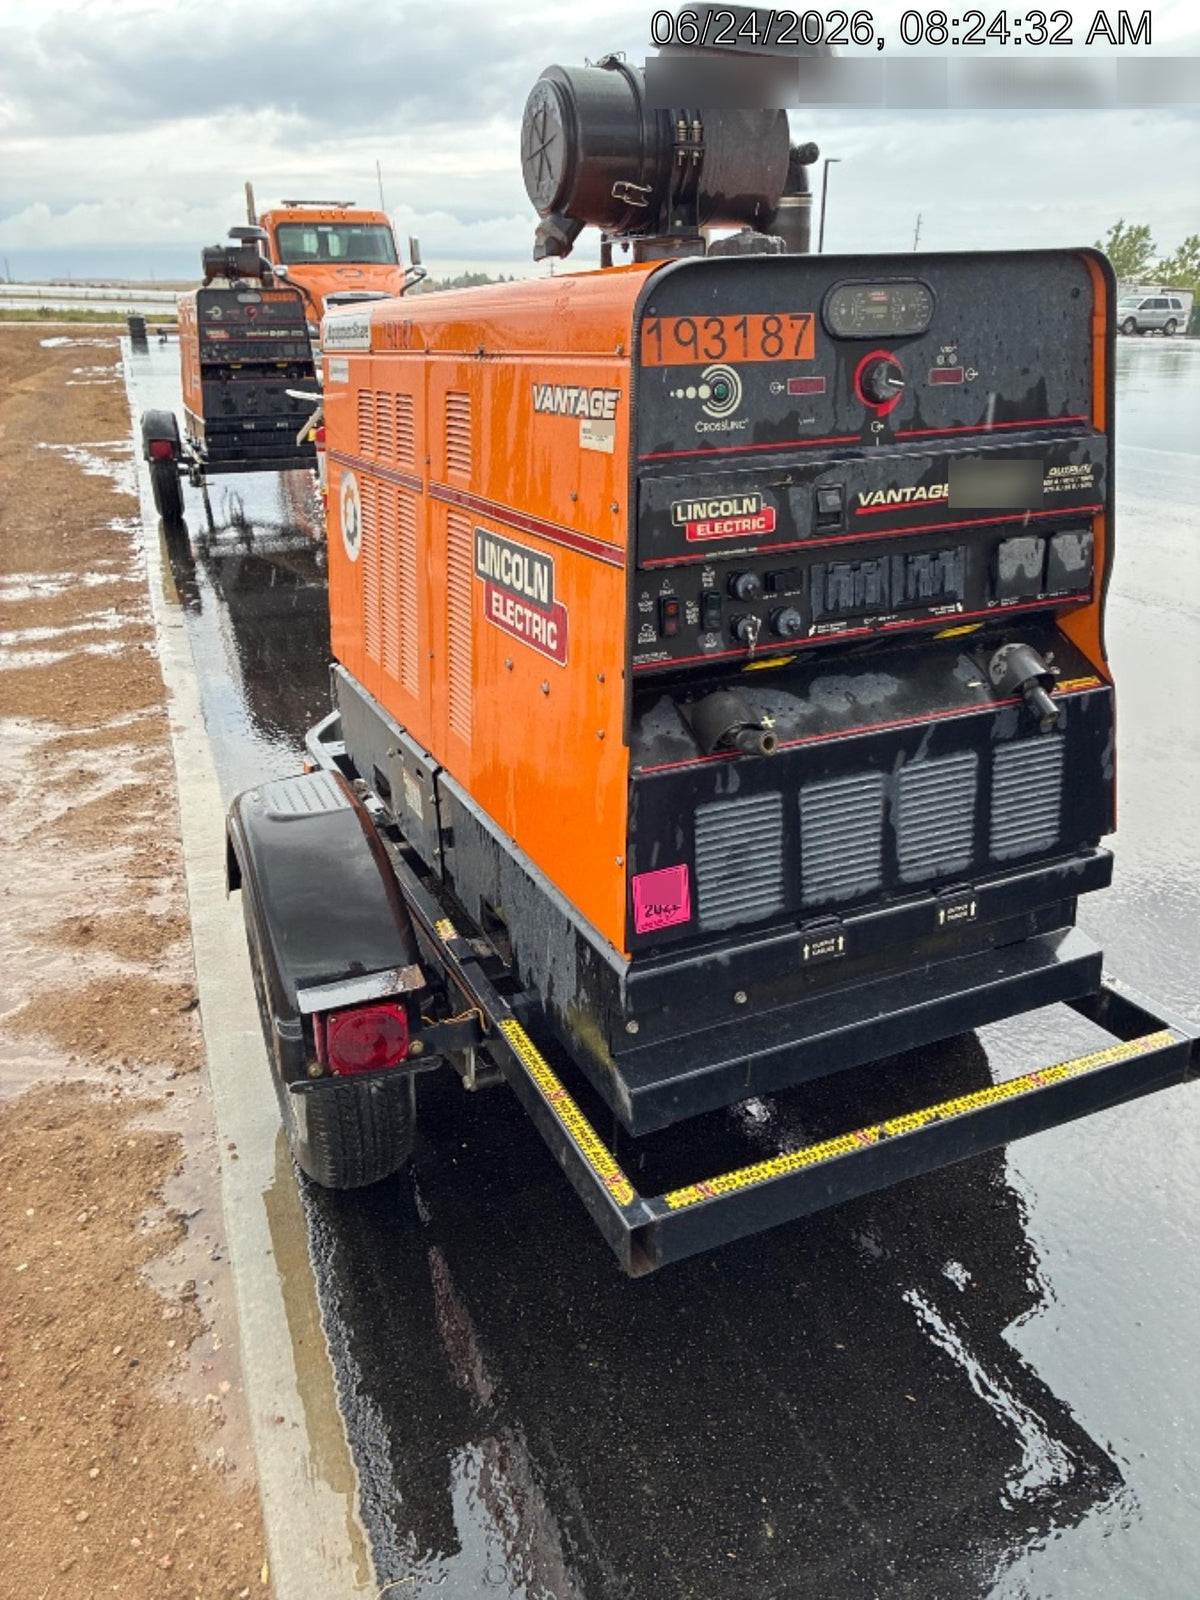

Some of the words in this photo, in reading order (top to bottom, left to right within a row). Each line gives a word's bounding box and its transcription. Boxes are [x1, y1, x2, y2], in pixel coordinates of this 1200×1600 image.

[647, 314, 812, 361] 193187
[533, 384, 618, 419] VANTAGE
[676, 497, 757, 521] LINCOLN
[696, 517, 766, 536] ELECTRIC
[477, 536, 549, 604] LINCOLN
[491, 589, 558, 651] ELECTRIC
